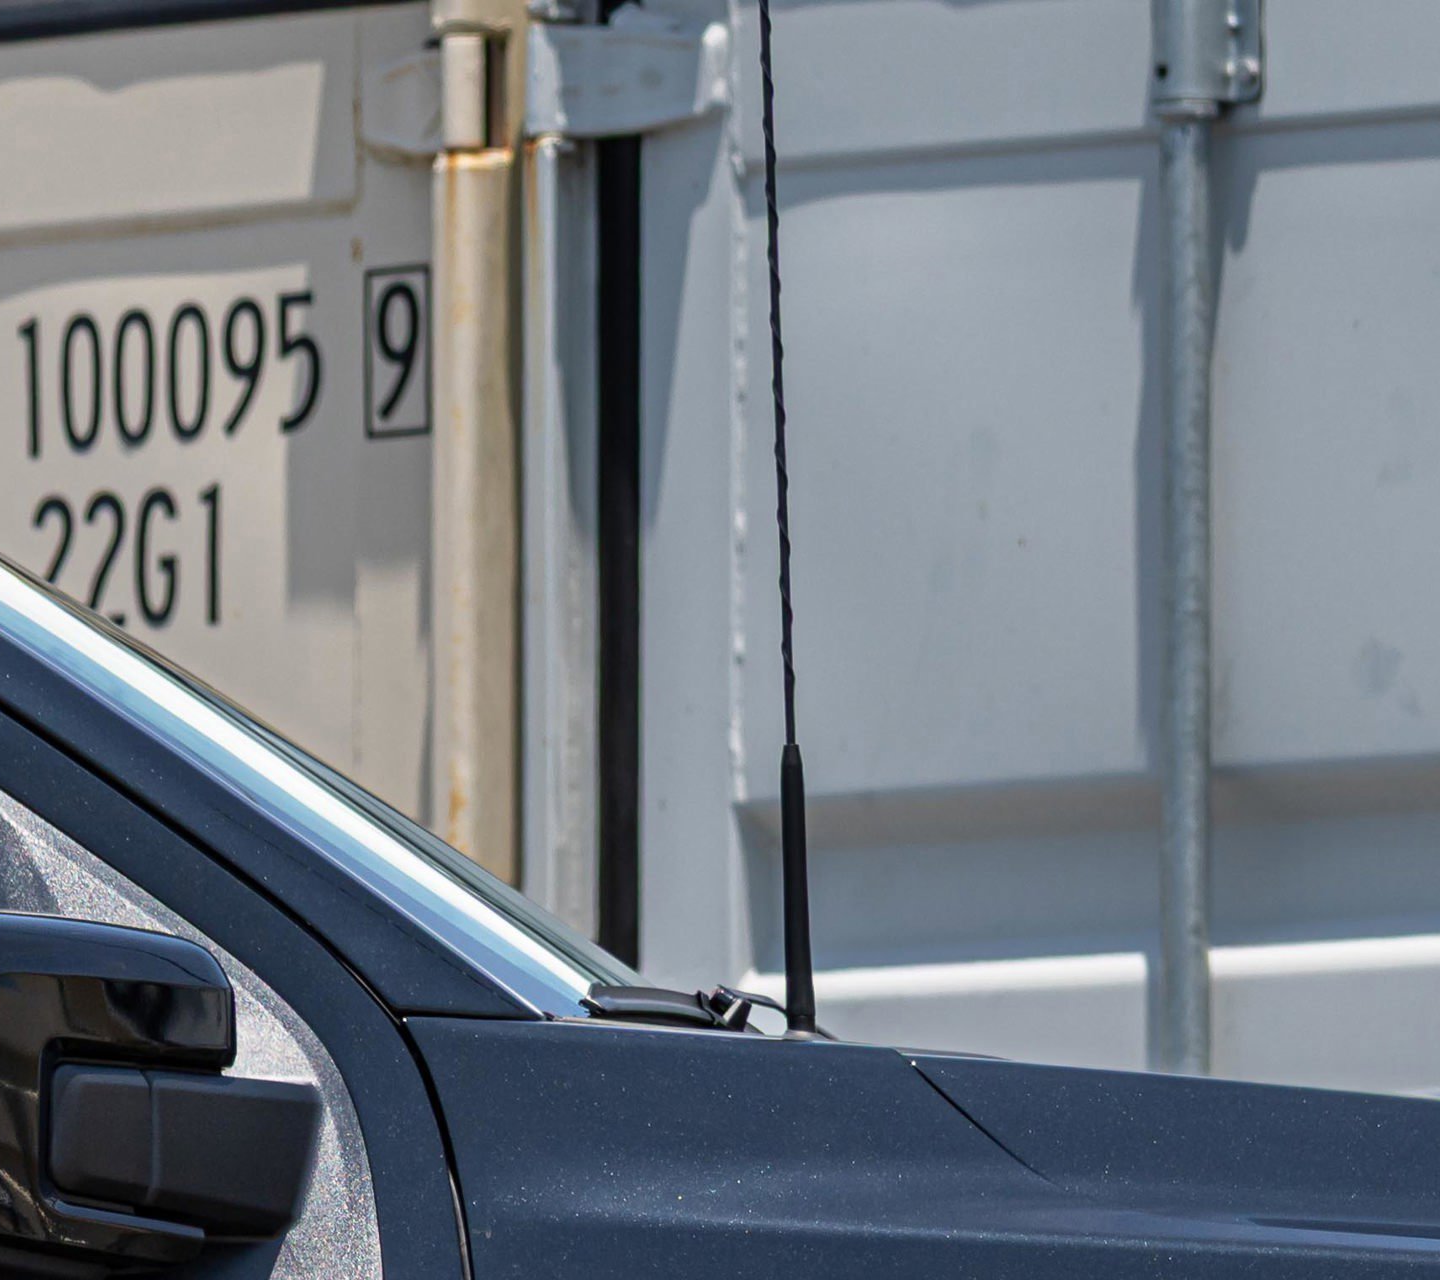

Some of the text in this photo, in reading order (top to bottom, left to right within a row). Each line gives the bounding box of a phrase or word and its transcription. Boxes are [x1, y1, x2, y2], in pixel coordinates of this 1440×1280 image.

[20, 291, 323, 458] 100095
[376, 281, 420, 421] 9
[33, 483, 223, 628] 22G1
